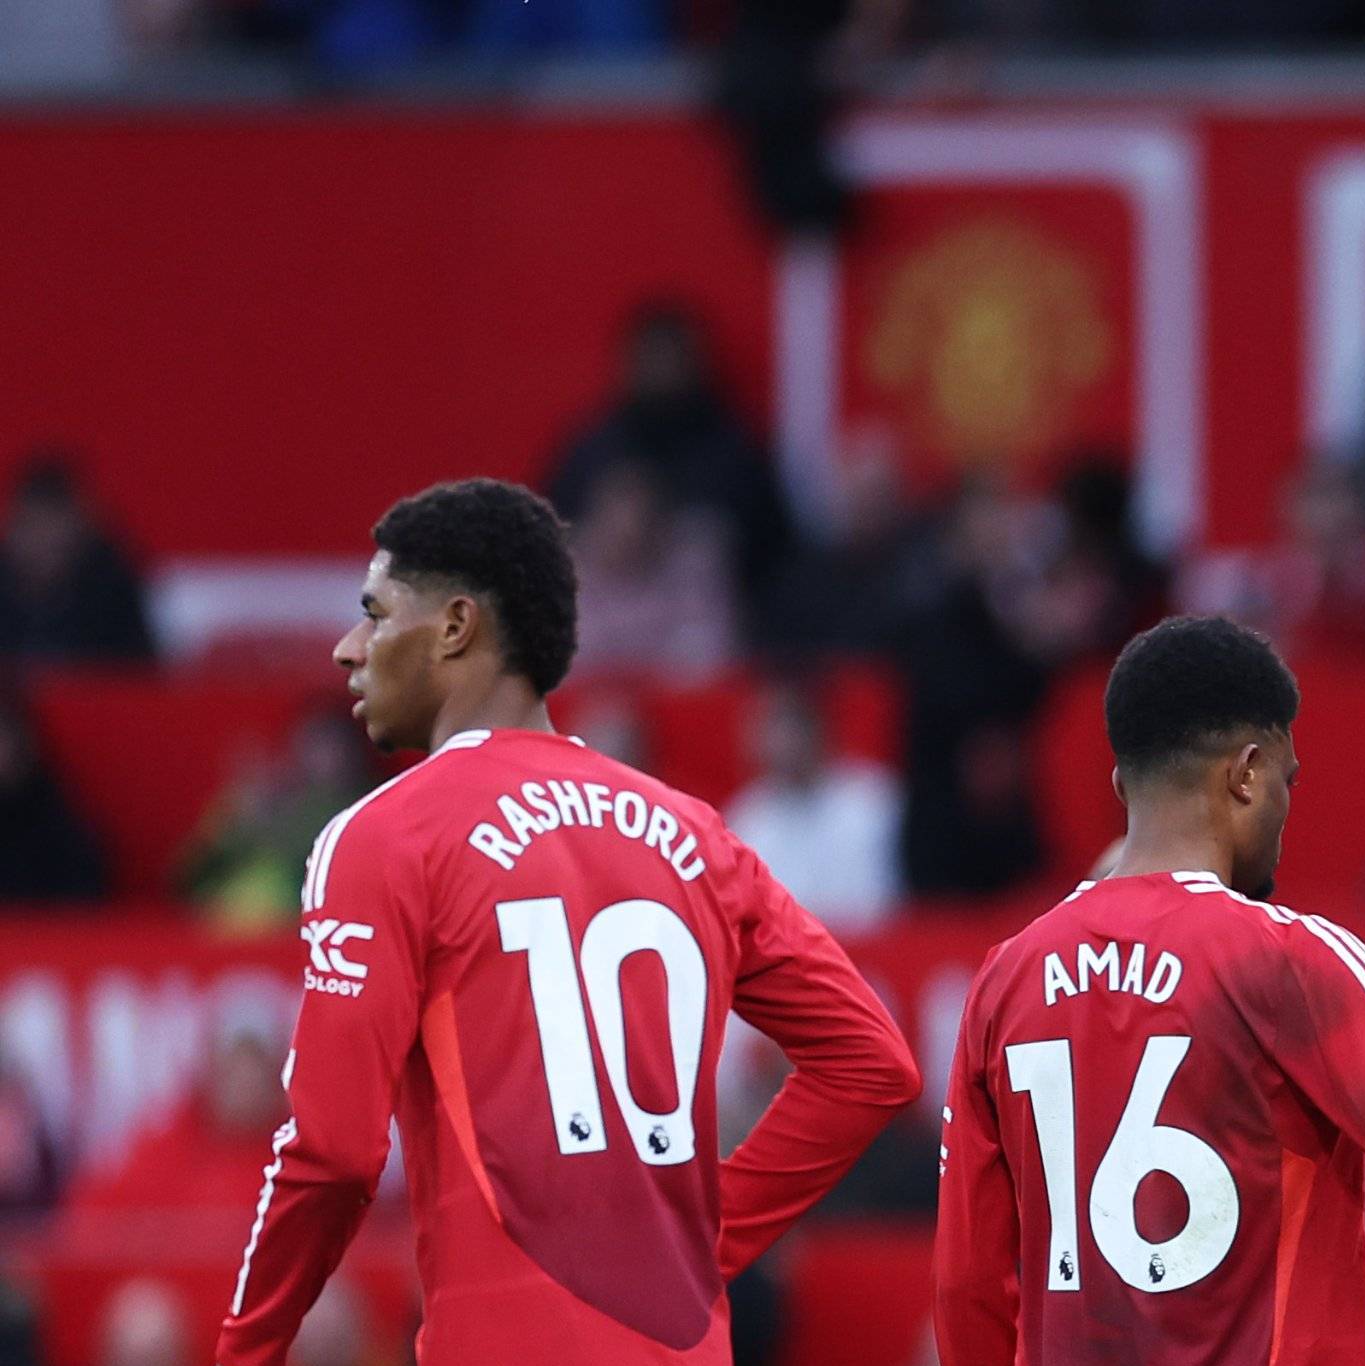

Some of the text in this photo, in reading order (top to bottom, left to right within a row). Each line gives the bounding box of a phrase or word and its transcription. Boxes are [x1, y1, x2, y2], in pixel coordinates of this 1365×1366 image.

[303, 965, 365, 998] OLOGY
[495, 896, 708, 1166] 10
[1044, 941, 1183, 1006] AMAD
[1005, 1035, 1240, 1293] 16
